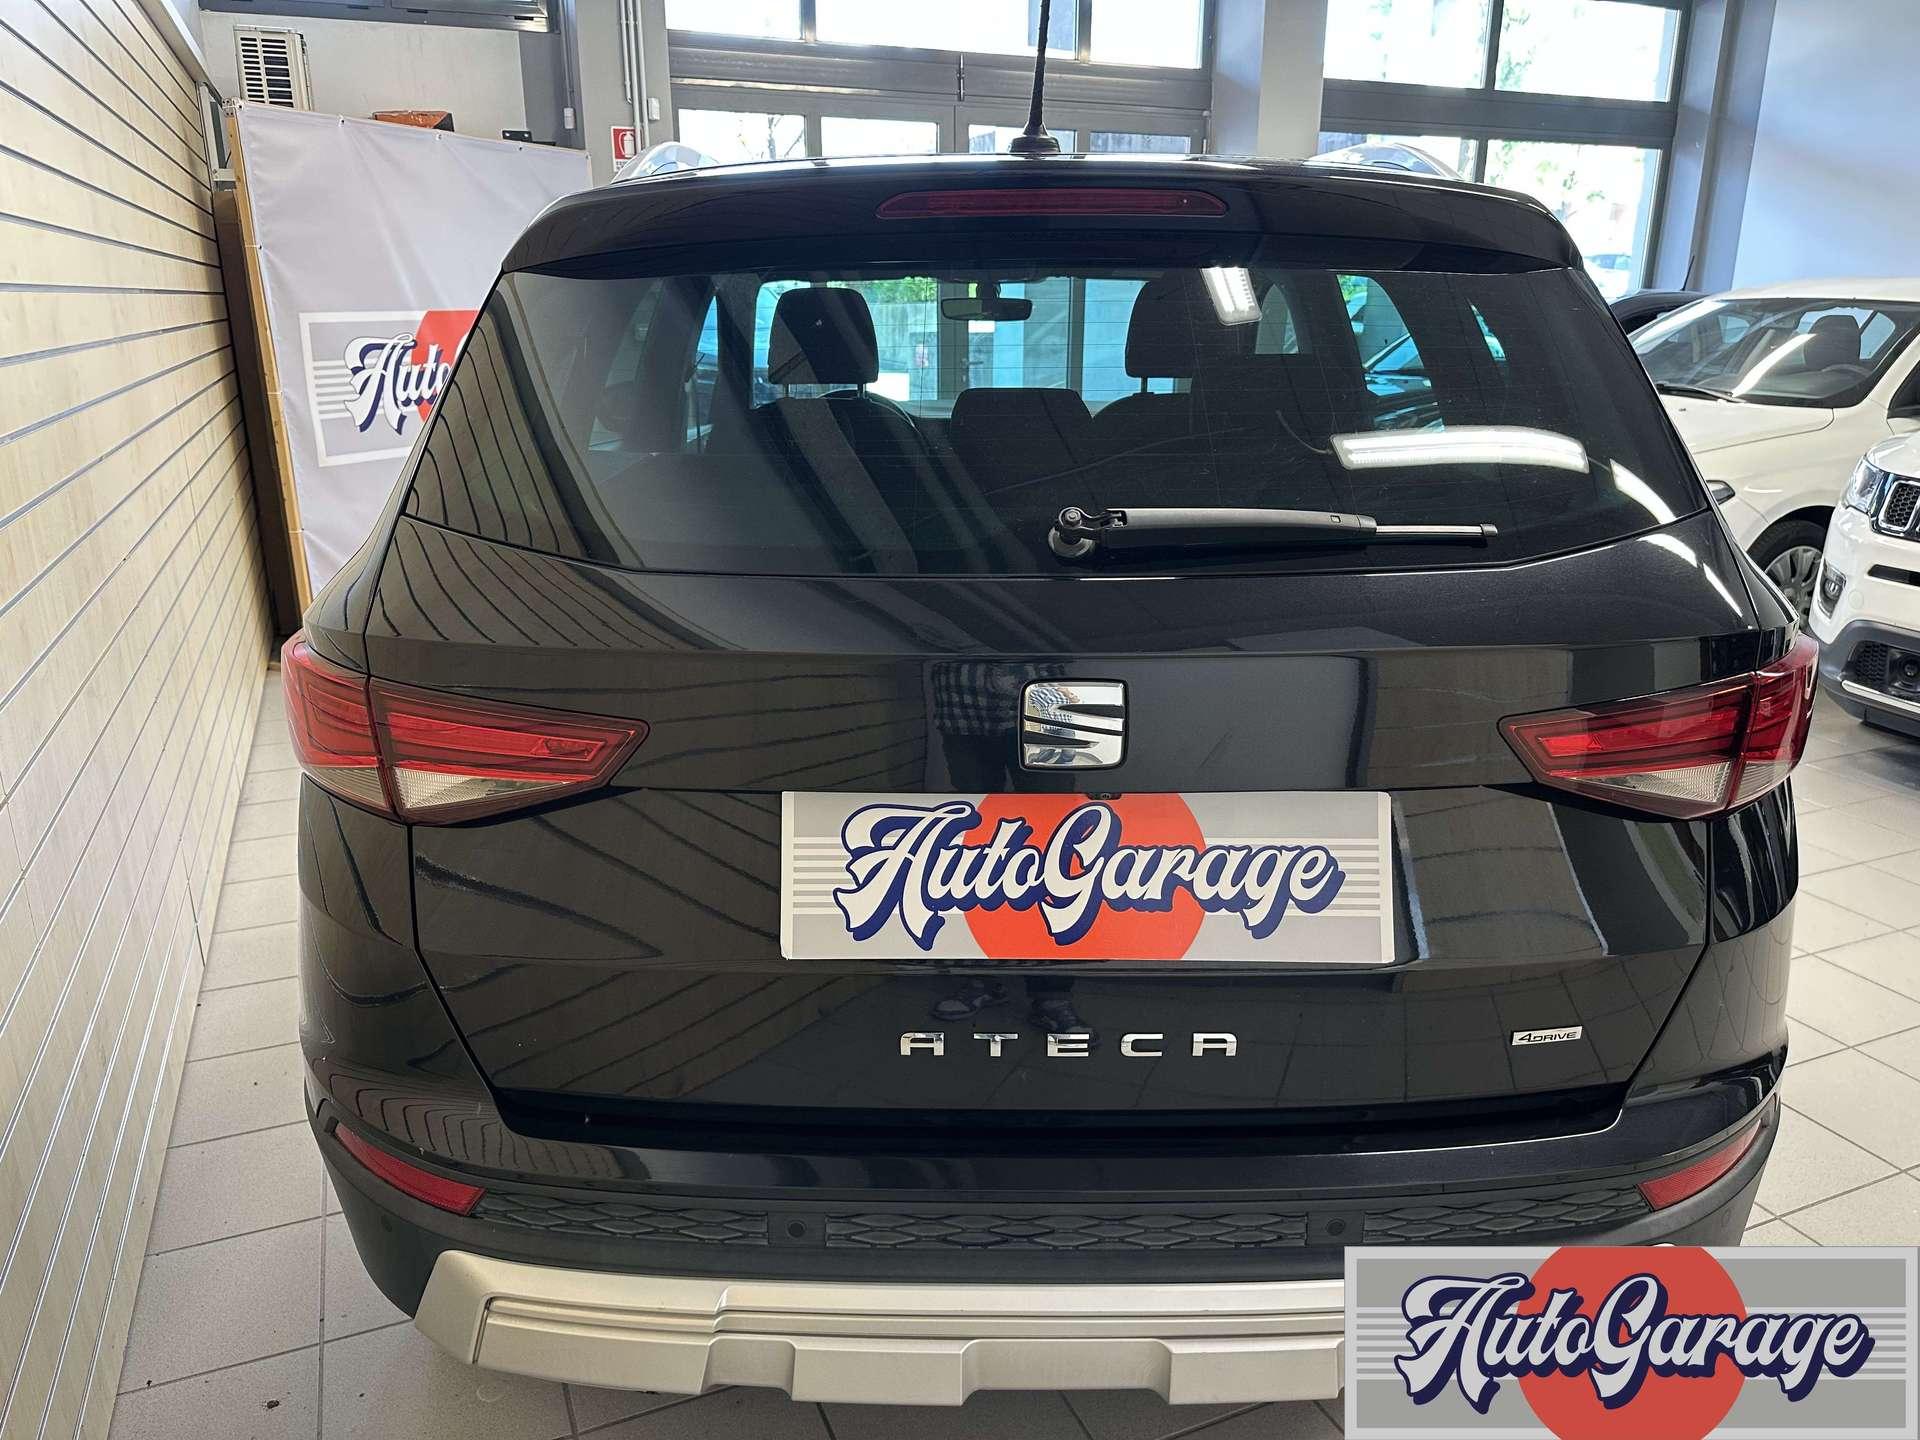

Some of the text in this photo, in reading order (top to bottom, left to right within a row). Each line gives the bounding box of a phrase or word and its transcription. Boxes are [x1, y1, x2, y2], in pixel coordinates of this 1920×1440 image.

[344, 332, 467, 435] Auto
[833, 801, 1346, 951] AutoGarage
[900, 1032, 1238, 1057] ATECA
[1517, 1031, 1578, 1043] 4DRIVE
